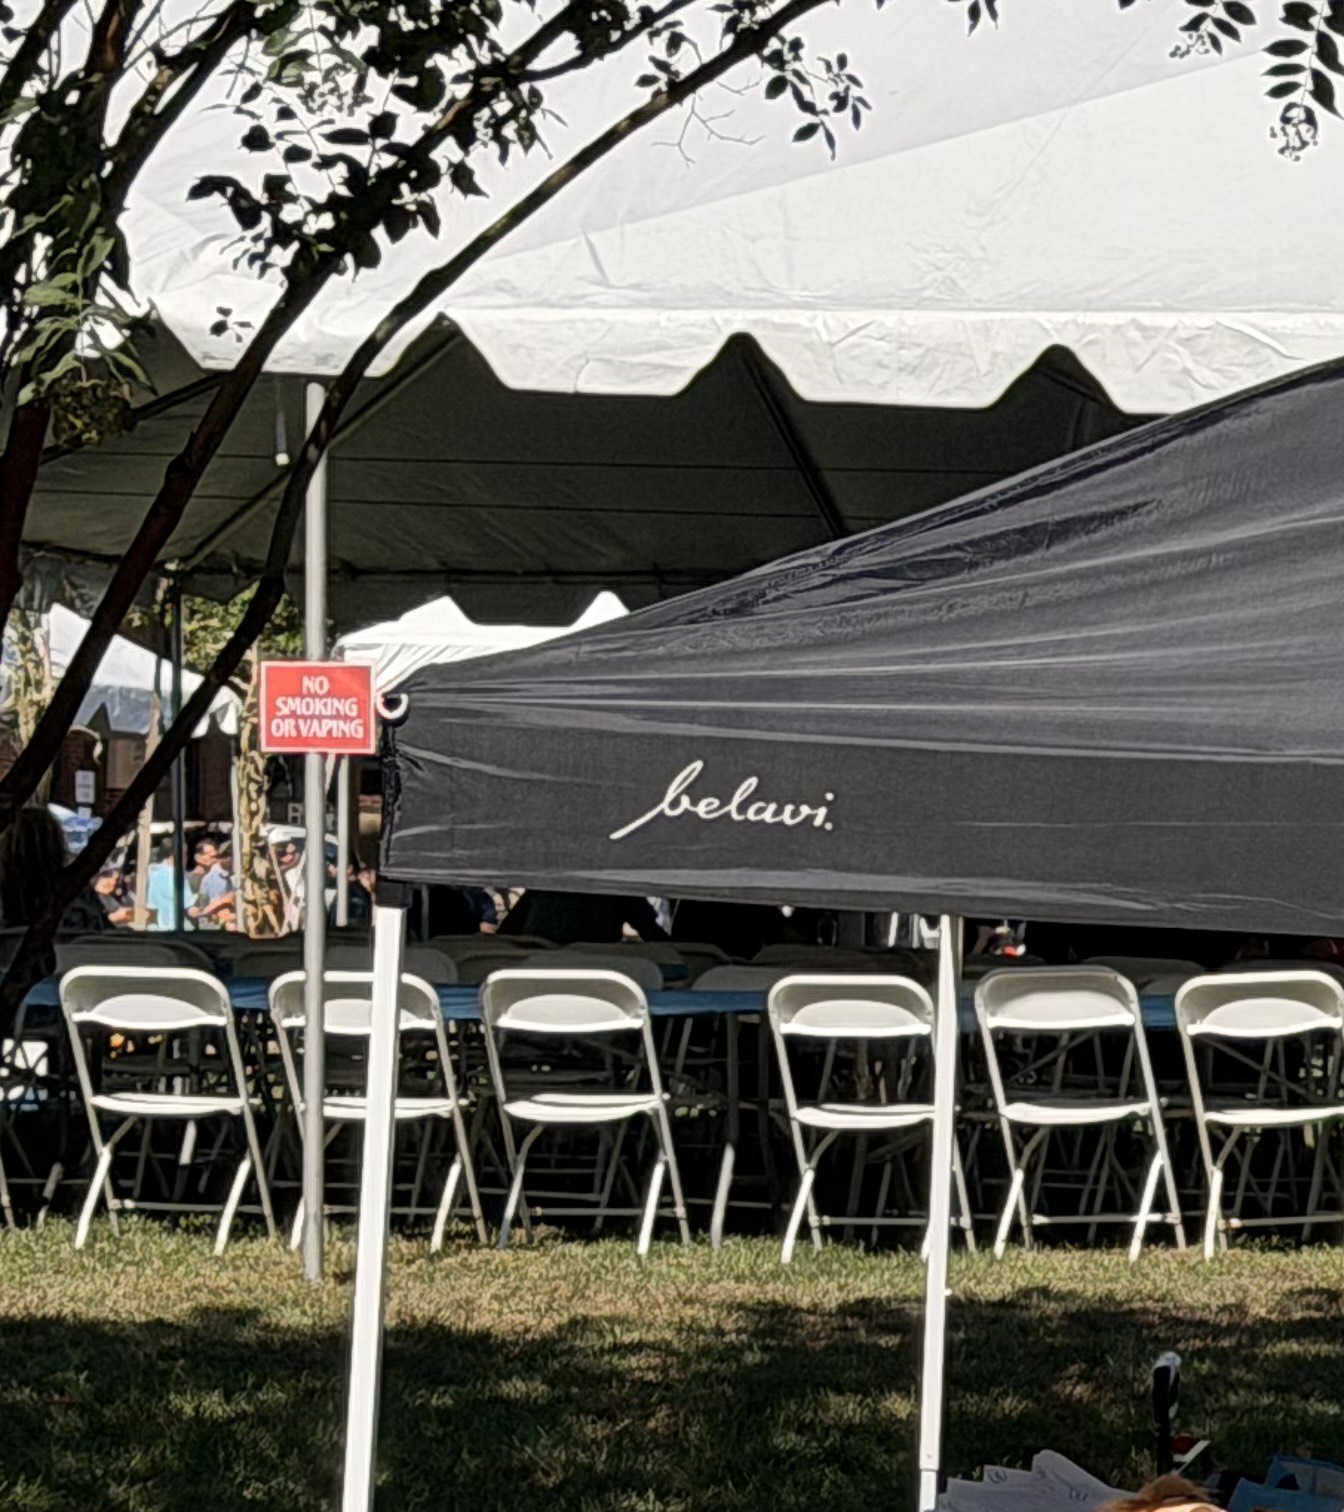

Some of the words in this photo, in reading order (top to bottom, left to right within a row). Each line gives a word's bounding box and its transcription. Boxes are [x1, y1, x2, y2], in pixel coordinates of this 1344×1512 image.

[302, 675, 330, 696] NO
[275, 696, 358, 717] SMOKING
[271, 718, 297, 738] OR
[298, 718, 365, 739] VAPING
